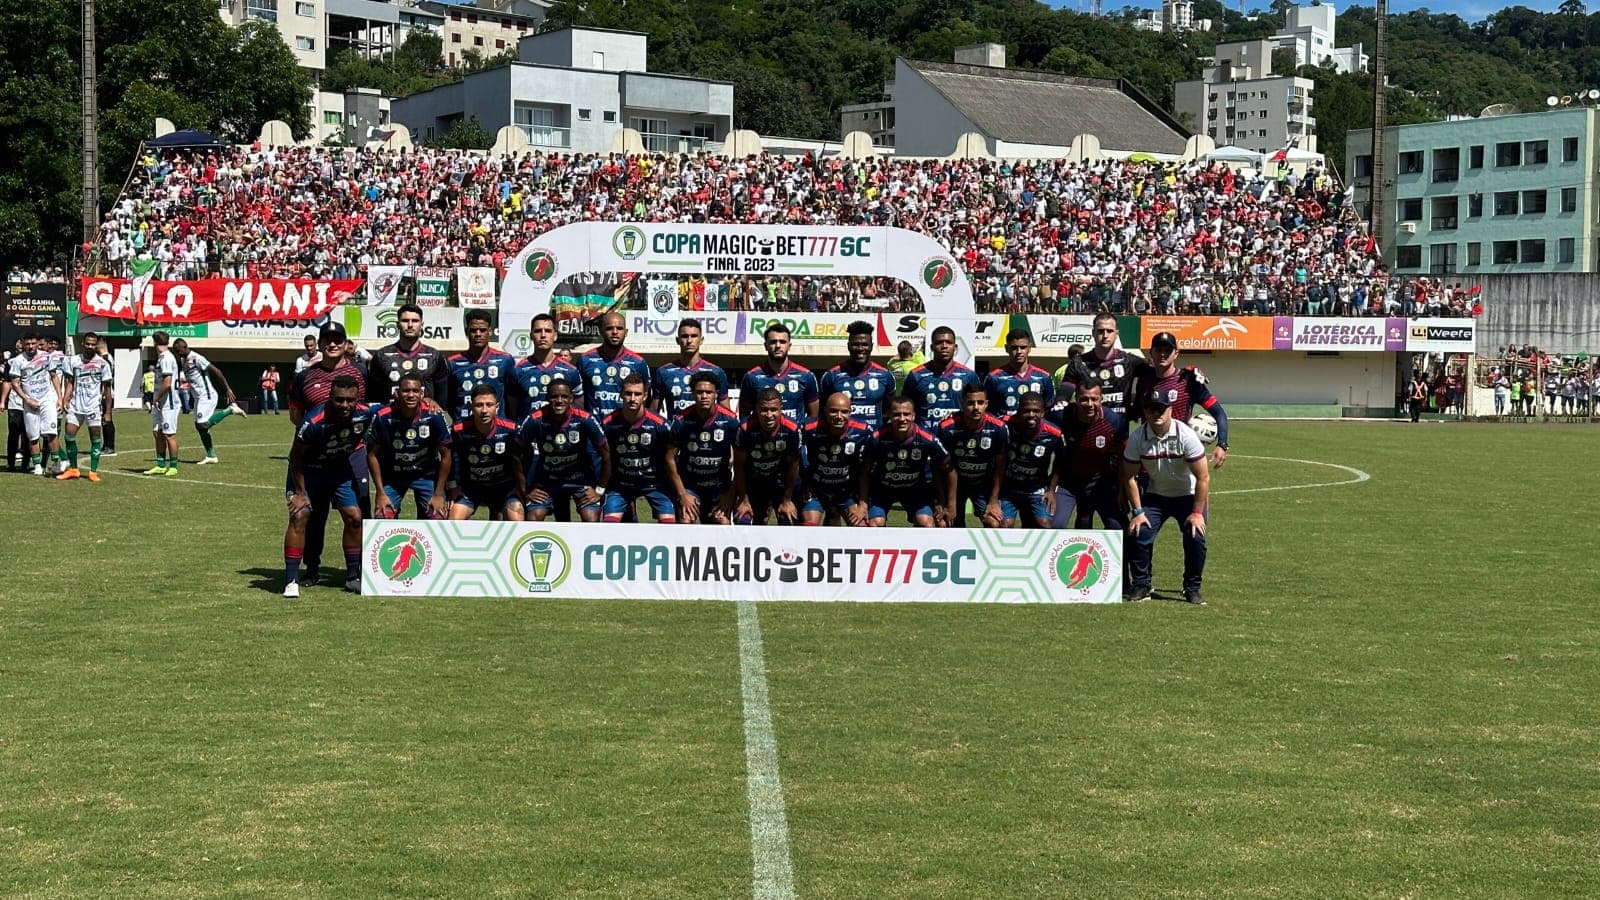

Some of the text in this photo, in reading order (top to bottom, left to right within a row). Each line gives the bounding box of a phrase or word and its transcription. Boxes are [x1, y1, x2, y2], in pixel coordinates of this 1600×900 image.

[652, 233, 700, 254] COPA
[704, 234, 757, 255] MAGIC
[840, 236, 870, 257] SC
[707, 257, 775, 271] FINAL 2023
[420, 283, 445, 294] NUNCA
[86, 281, 193, 318] GALO
[377, 325, 452, 339] ROSAT
[633, 316, 727, 336] PROTEC
[813, 323, 849, 336] BRA
[1041, 334, 1092, 343] KERBER
[1295, 334, 1383, 345] MENEGATTI
[583, 544, 976, 585] COPA MAGIC BET777 SC
